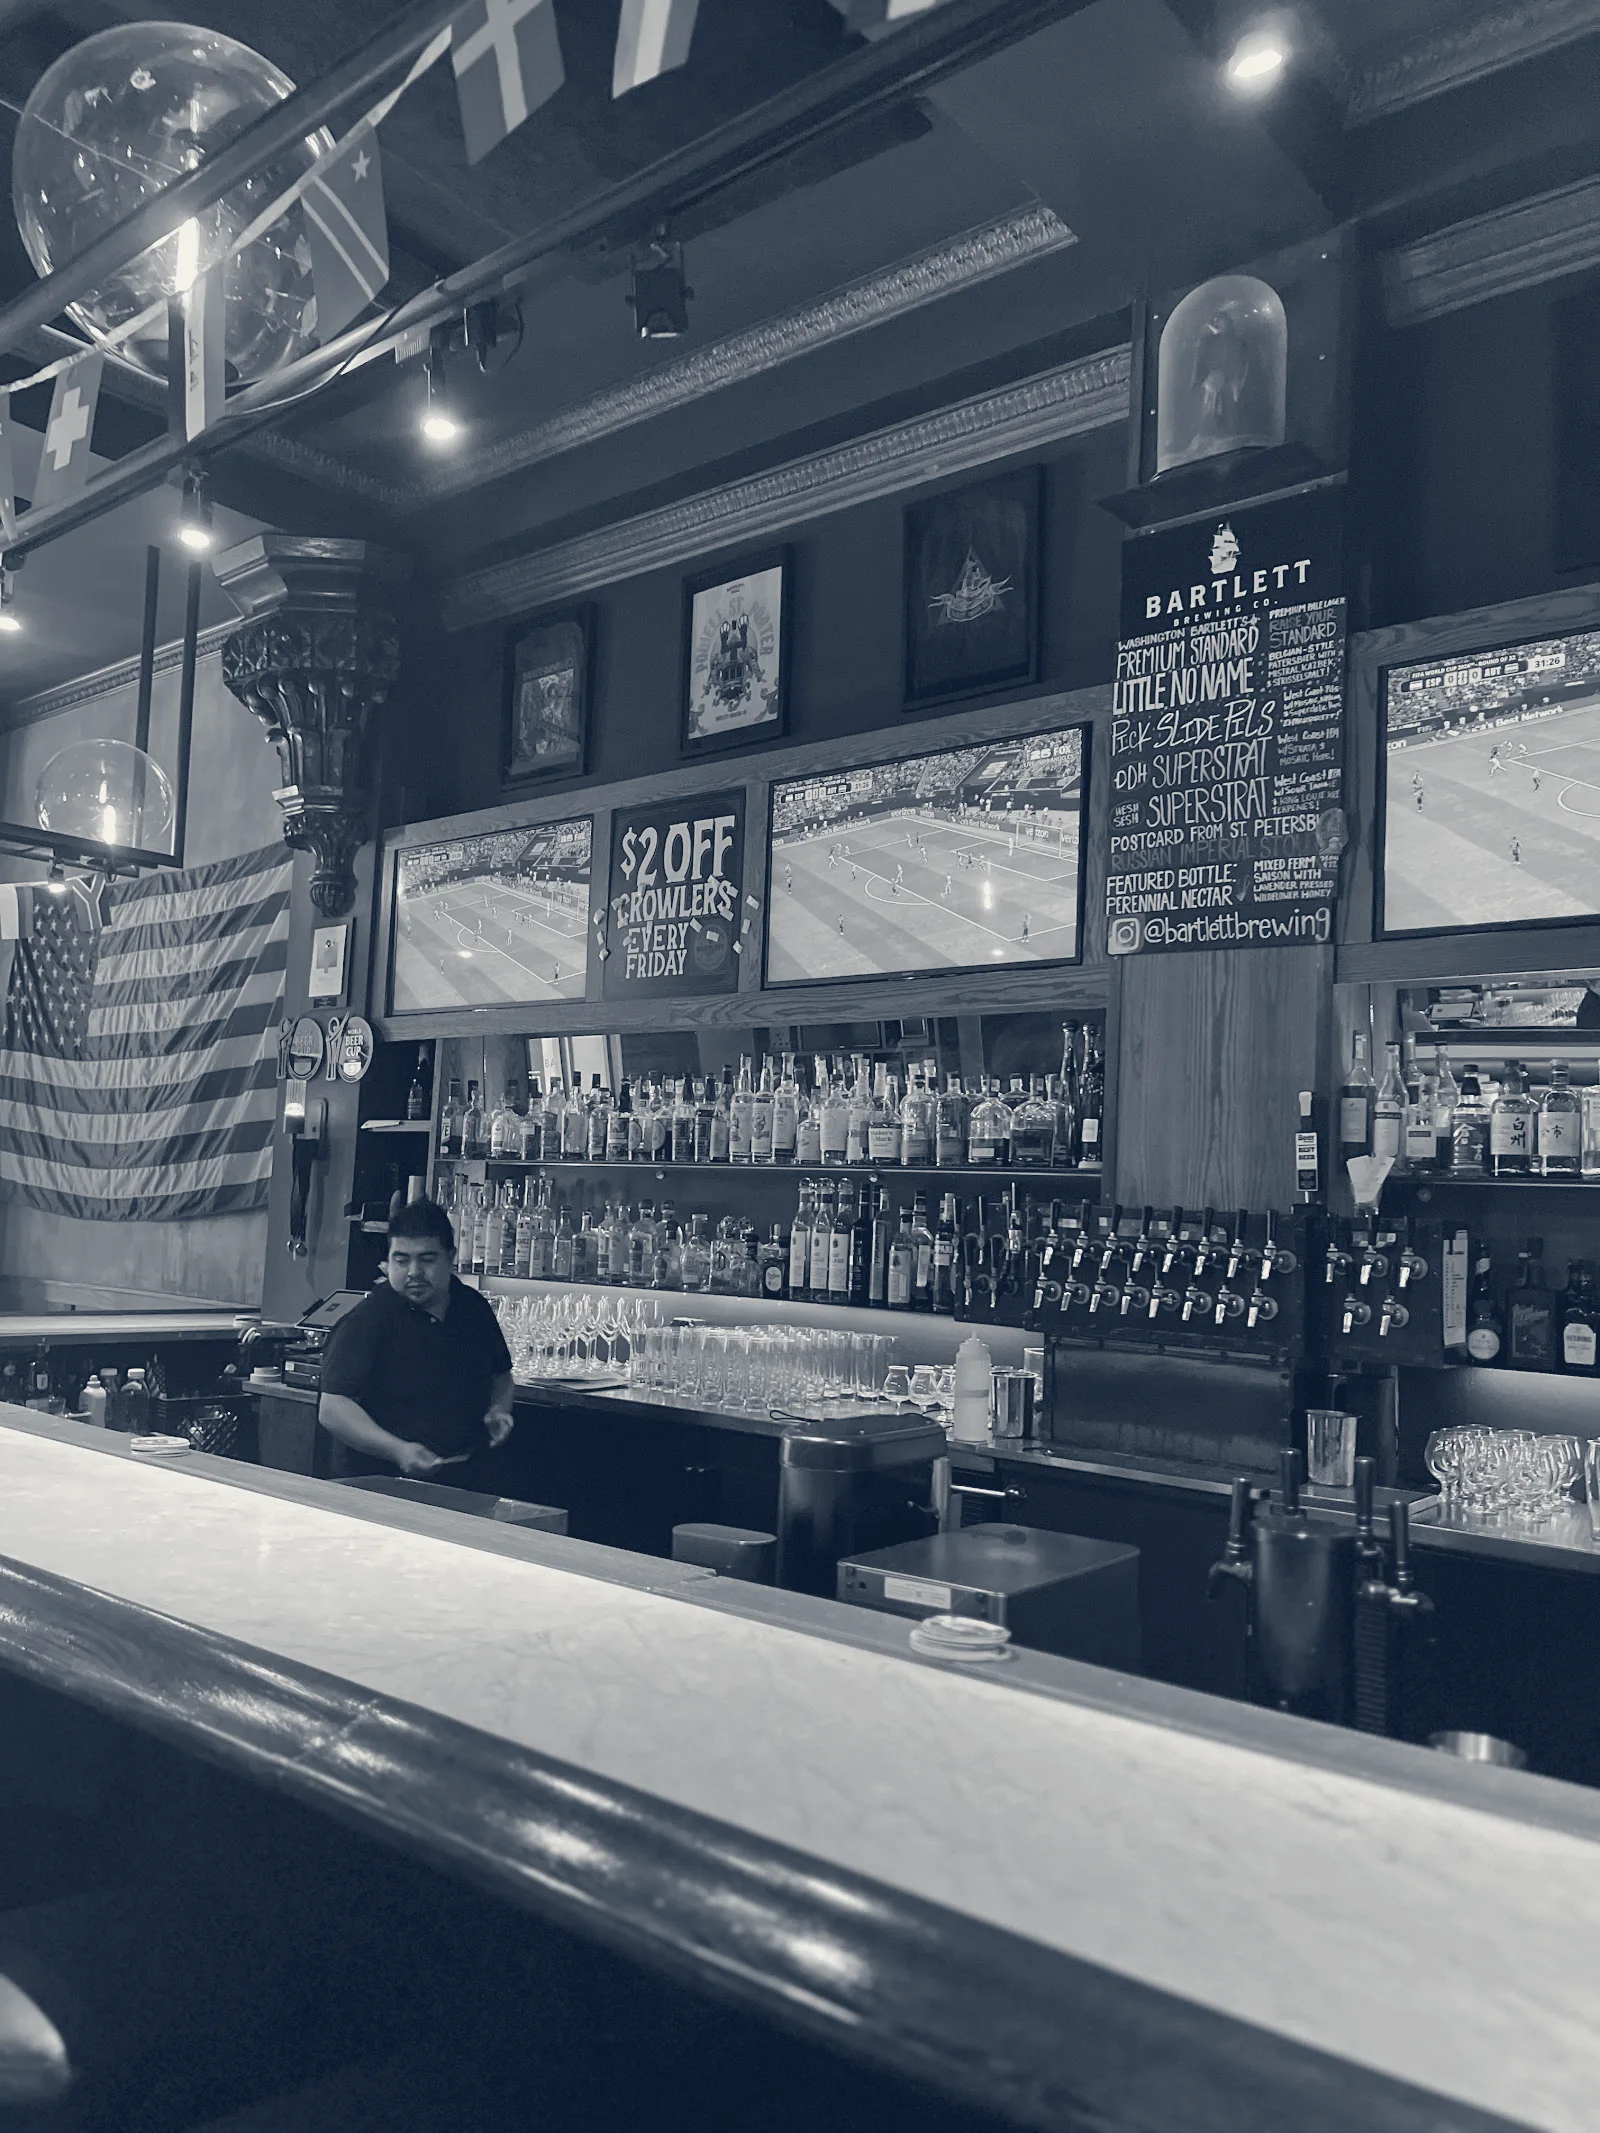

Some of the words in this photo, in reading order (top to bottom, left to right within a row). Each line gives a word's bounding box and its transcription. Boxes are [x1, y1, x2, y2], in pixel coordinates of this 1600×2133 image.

[1145, 558, 1311, 618] BARTLETT
[1173, 606, 1242, 627] BREWING
[1253, 598, 1278, 609] CO.
[1118, 628, 1185, 651] WASHINGTON
[1190, 617, 1248, 637] BARTLETT'S
[1269, 621, 1337, 648] STANDARD
[1116, 641, 1185, 679] PREMIUM
[1190, 626, 1259, 666] STANDARD
[1534, 656, 1561, 669] 31:26
[1112, 672, 1167, 716] LITTLE
[1170, 667, 1198, 708] NO
[1200, 657, 1254, 703] NAME
[1425, 677, 1442, 688] ESP
[1484, 666, 1502, 678] AUT
[1153, 710, 1221, 749] SLIDE
[1223, 698, 1276, 743] PILS
[1521, 705, 1563, 722] Network
[1113, 762, 1147, 790] DDH
[1152, 736, 1273, 789] SUPERSTRAT
[1146, 776, 1270, 828] SUPERSTRAT
[1113, 815, 1139, 828] SESH
[620, 826, 658, 887] $2
[663, 815, 736, 884] OFF
[1110, 828, 1184, 854] POSTCARD
[1190, 822, 1223, 843] FROM
[1230, 821, 1248, 838] ST.
[1110, 847, 1172, 872] RUSSIAN
[1253, 858, 1286, 872] MIXED
[1288, 855, 1316, 870] FERM
[1106, 870, 1175, 896] FEATURED
[1253, 870, 1290, 884] SAISON
[1293, 869, 1322, 879] WITH
[1253, 881, 1298, 893] LAVENDER
[1300, 880, 1335, 890] PRESSED
[1106, 890, 1179, 915] PERENNIAL
[1181, 885, 1234, 909] NECTAR
[1253, 890, 1300, 903] WILDFLOWER
[1301, 889, 1332, 899] HONEY
[627, 922, 689, 954] EVERY
[1144, 907, 1331, 945] @bartlettbrewing
[625, 949, 688, 979] FRIDAY
[345, 1035, 364, 1046] BEER
[346, 1046, 361, 1057] CUP
